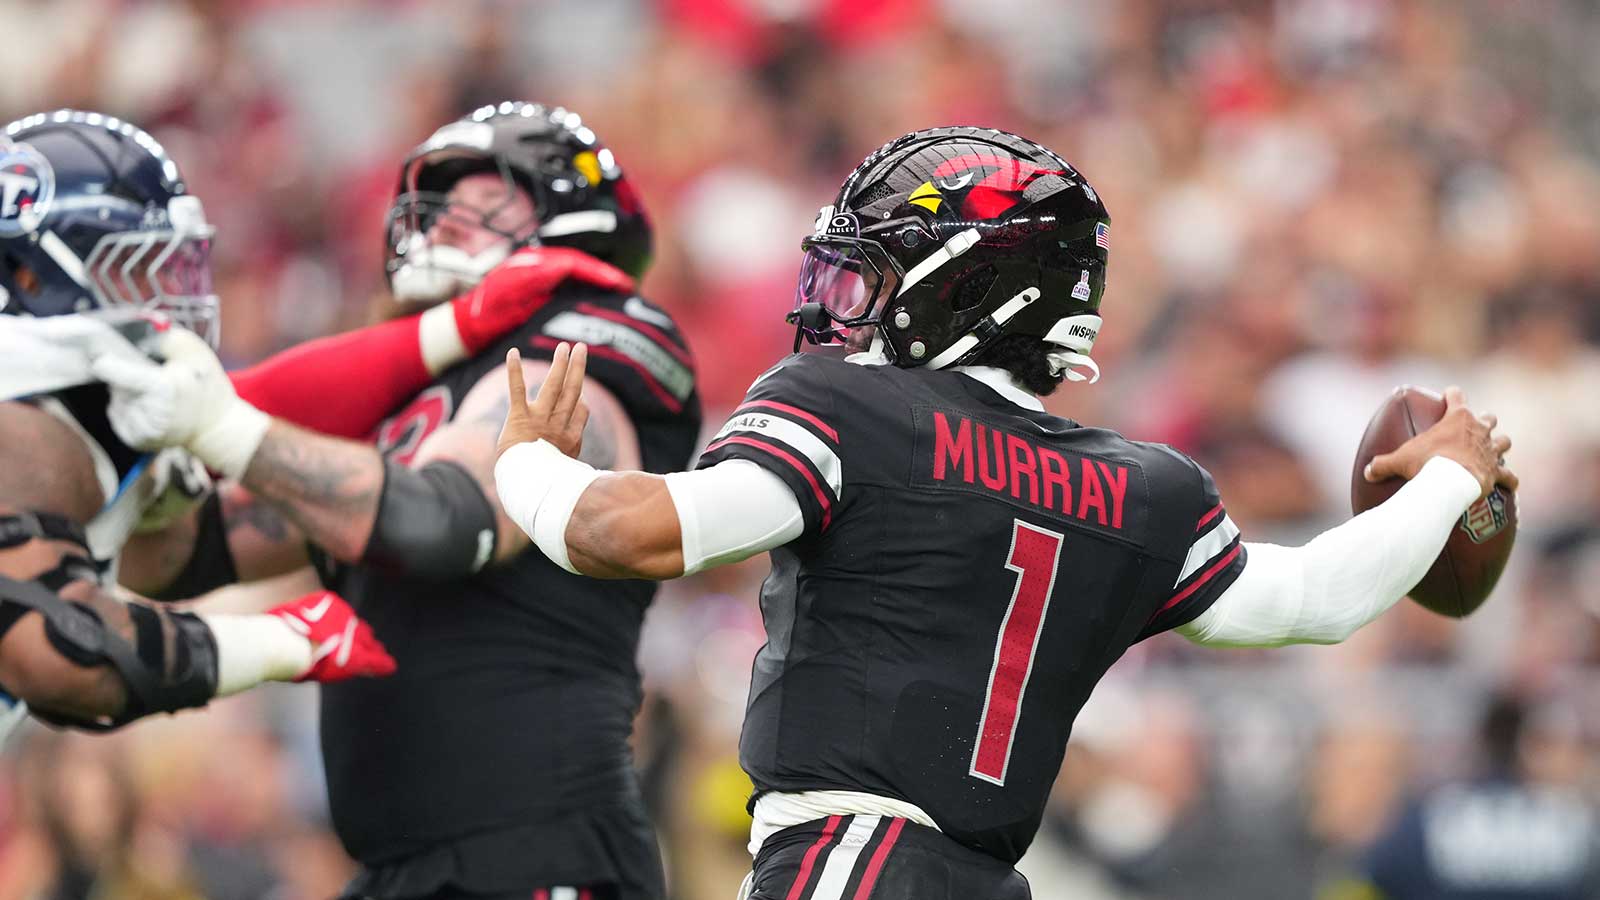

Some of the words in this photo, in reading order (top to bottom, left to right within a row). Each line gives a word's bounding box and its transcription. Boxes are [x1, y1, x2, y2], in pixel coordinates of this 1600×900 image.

[827, 226, 855, 234] OAKLEY
[933, 411, 1128, 529] MURRAY
[1468, 499, 1493, 537] NFL
[968, 518, 1064, 787] 1
